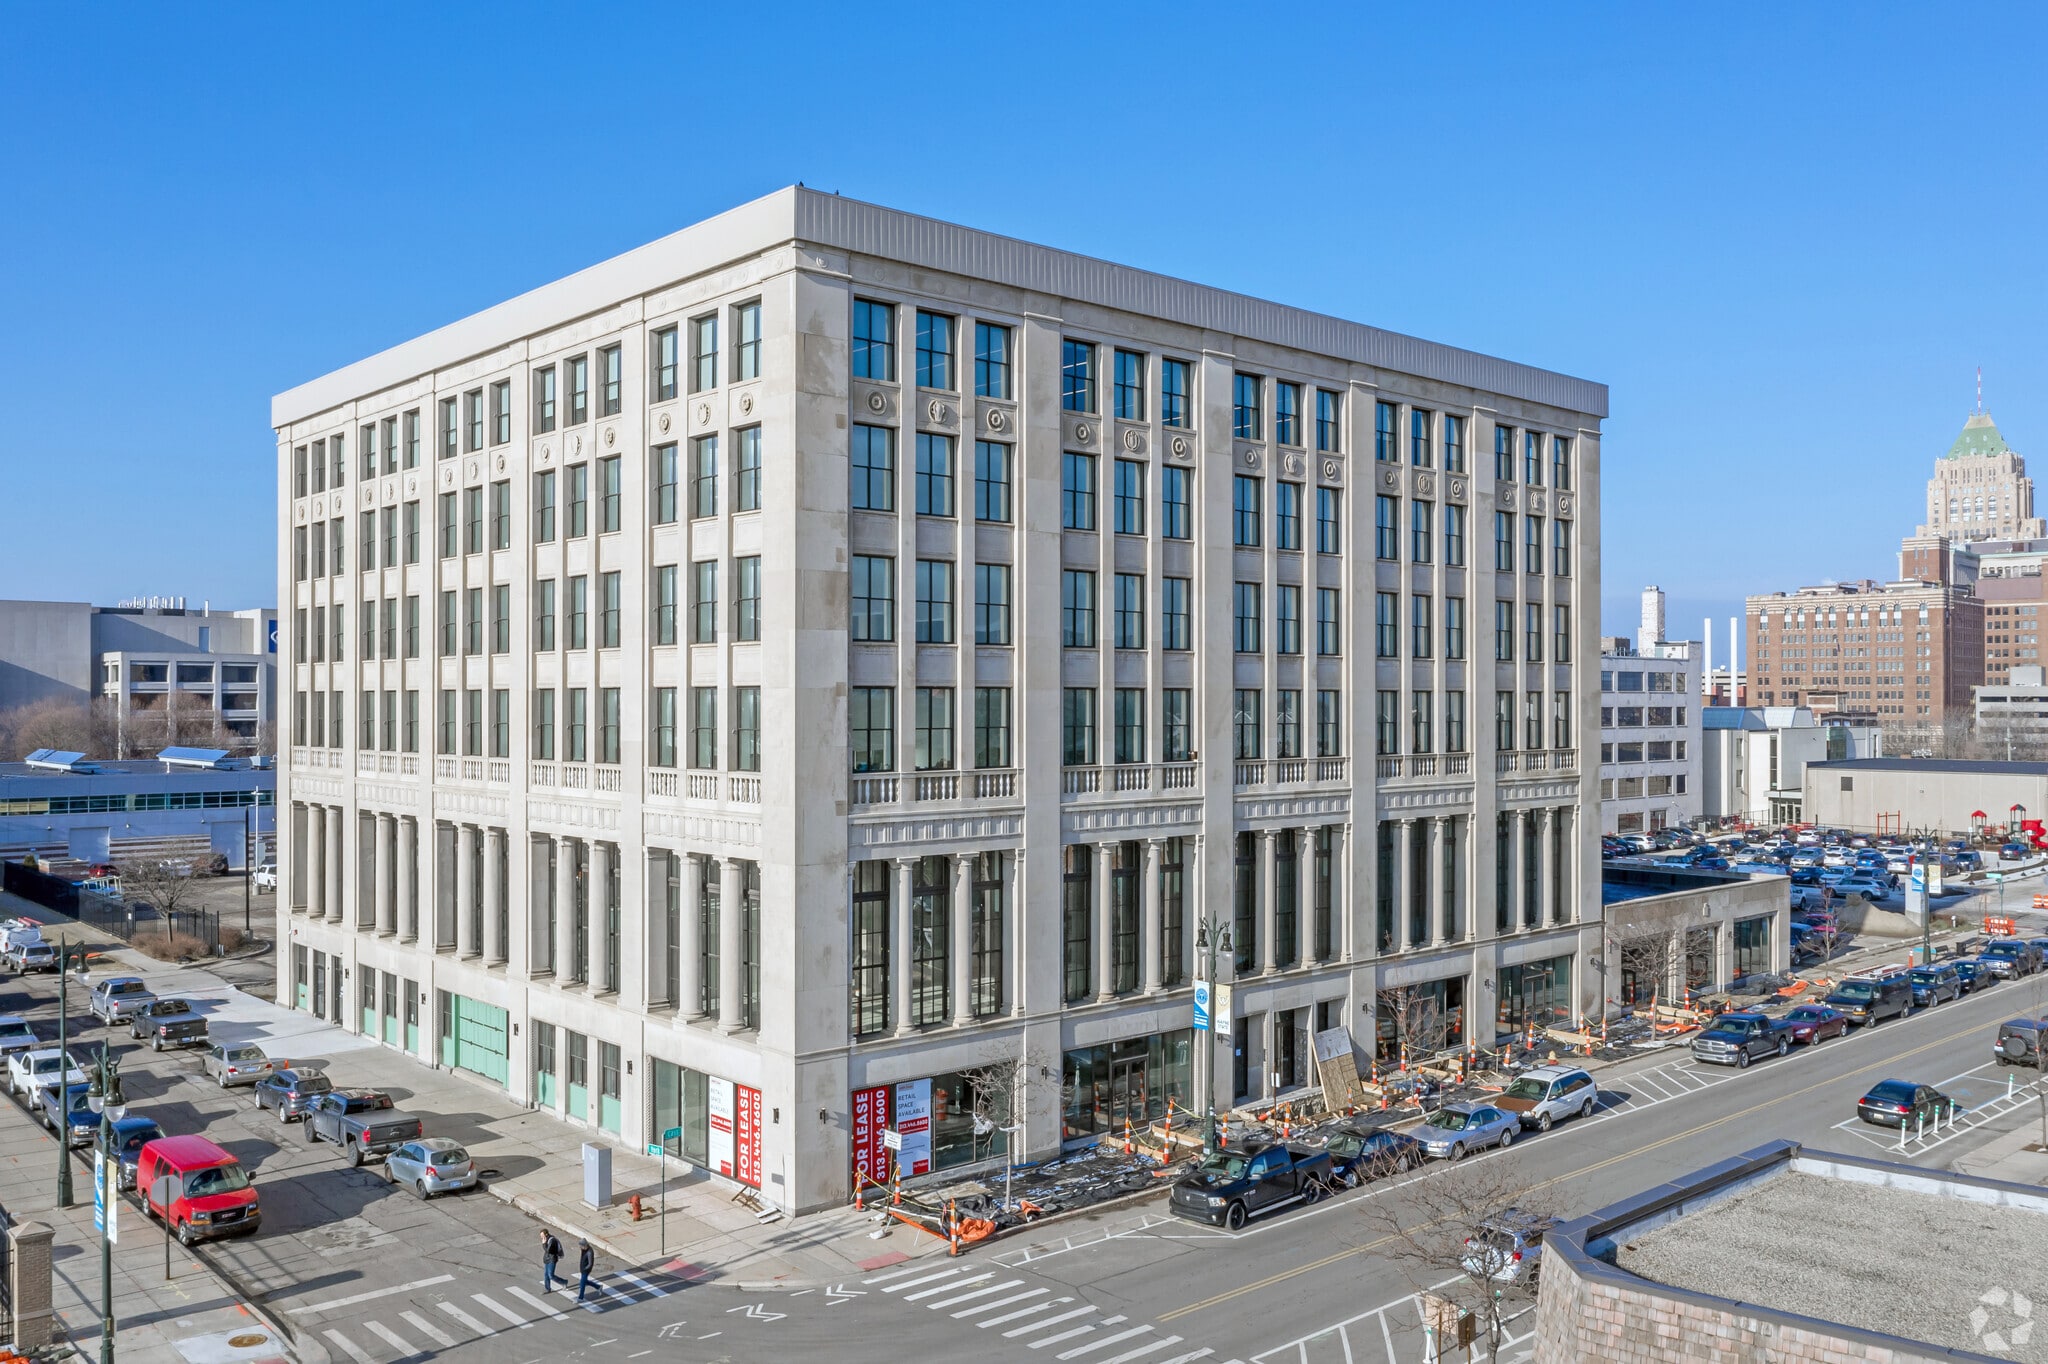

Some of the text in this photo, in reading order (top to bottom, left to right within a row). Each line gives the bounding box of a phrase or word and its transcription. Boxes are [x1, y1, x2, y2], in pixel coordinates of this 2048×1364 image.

[856, 1092, 868, 1143] LEASE
[898, 1094, 916, 1102] RETAIL
[898, 1107, 925, 1117] AVAILABLE
[740, 1087, 749, 1179] FOR LEASE
[876, 1090, 885, 1179] 313.446.8600
